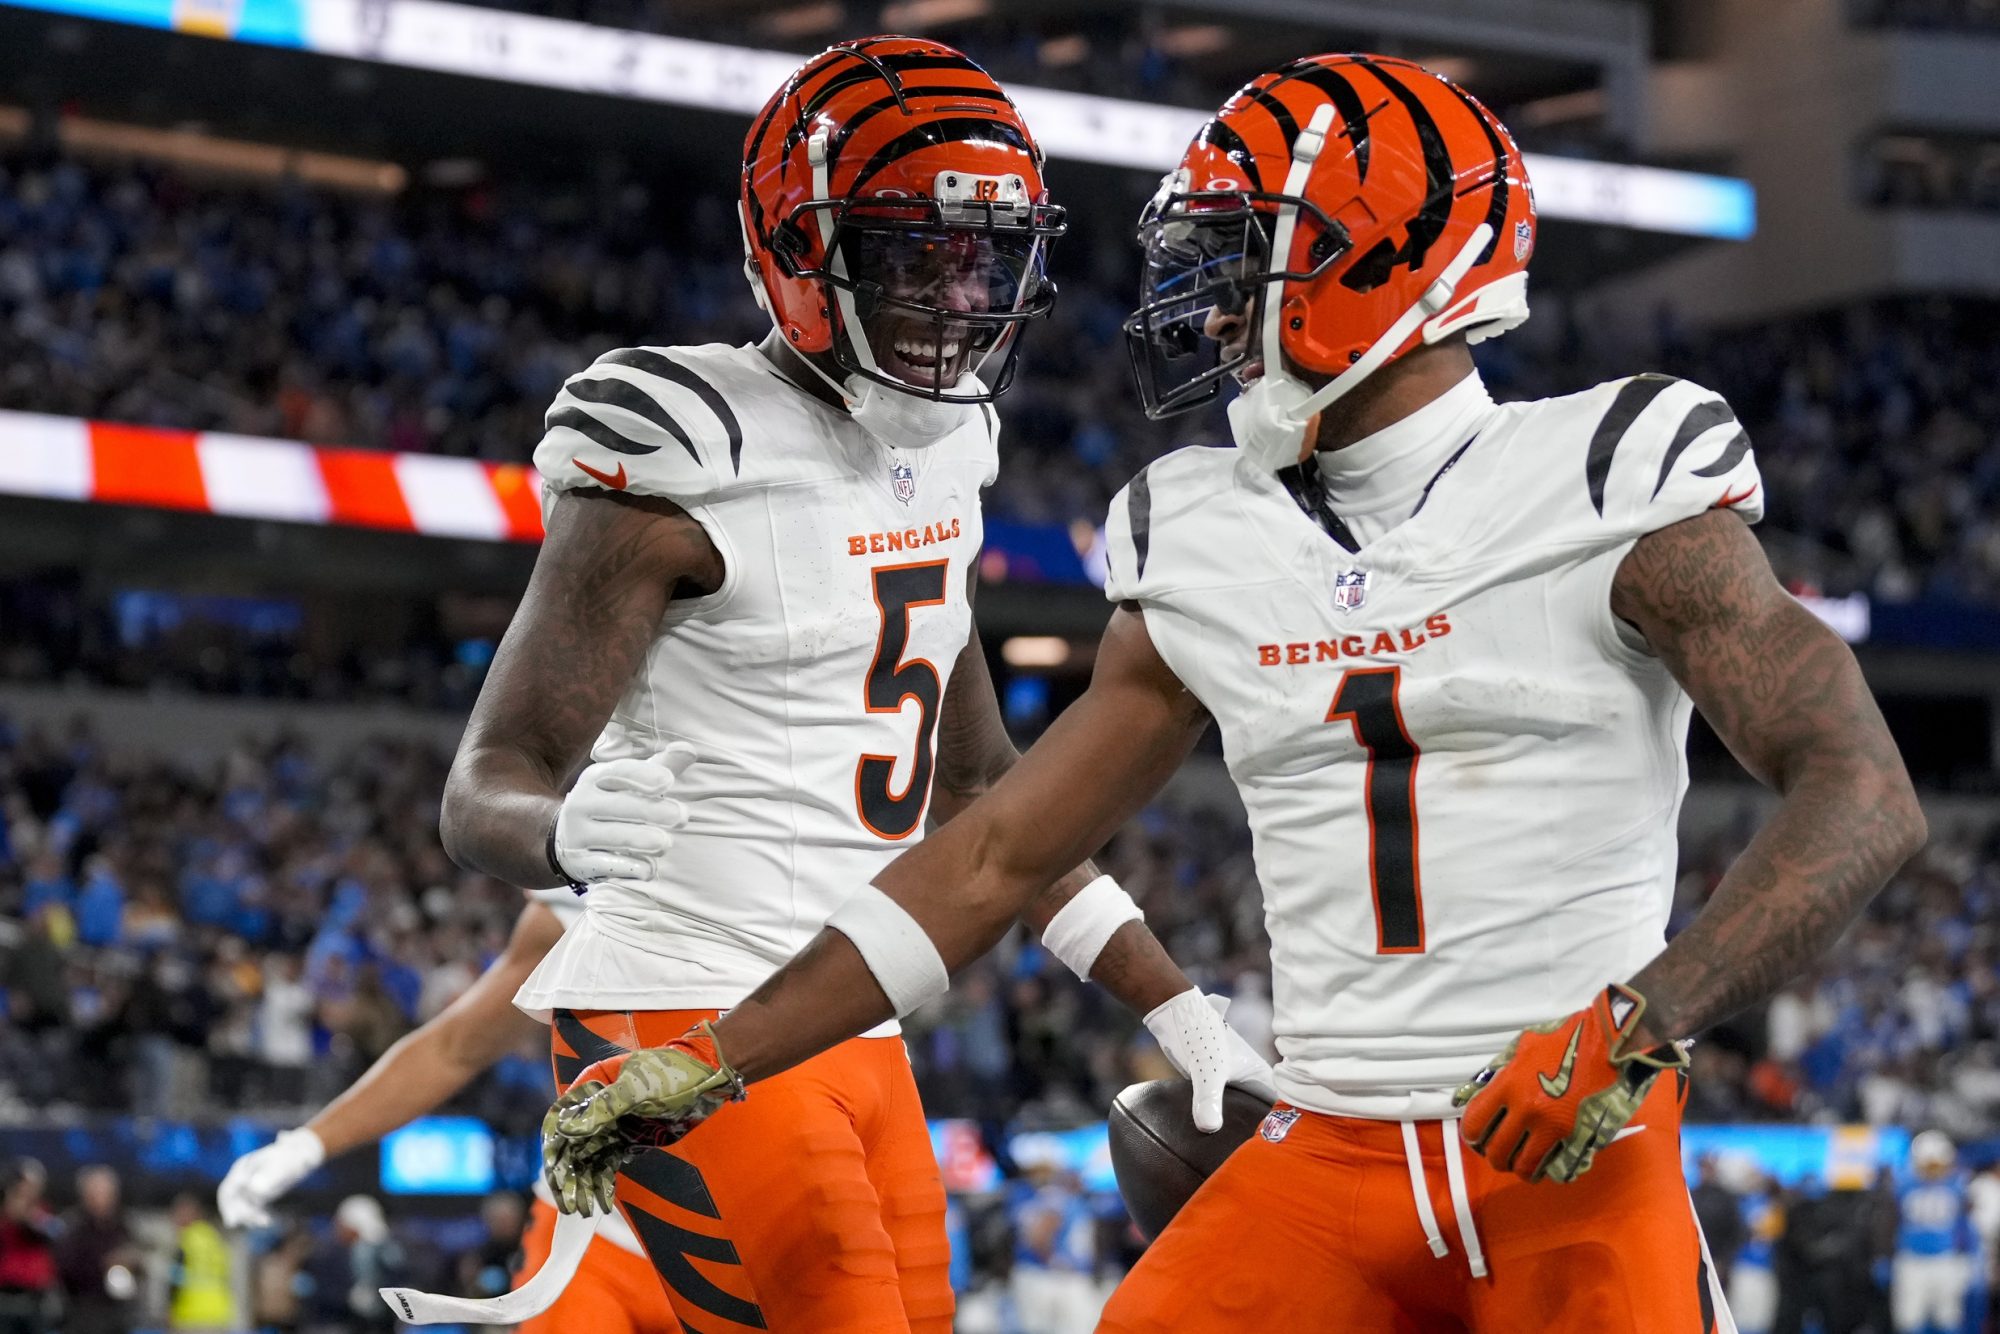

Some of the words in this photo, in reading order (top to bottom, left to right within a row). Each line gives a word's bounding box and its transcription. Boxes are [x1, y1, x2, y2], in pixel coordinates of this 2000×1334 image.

[896, 480, 913, 496] NFL
[848, 518, 960, 556] BENGALS
[1337, 587, 1361, 605] NFL
[1258, 614, 1451, 666] BENGALS
[855, 558, 949, 840] 5
[1324, 666, 1425, 954] 1
[1264, 1117, 1285, 1138] NFL
